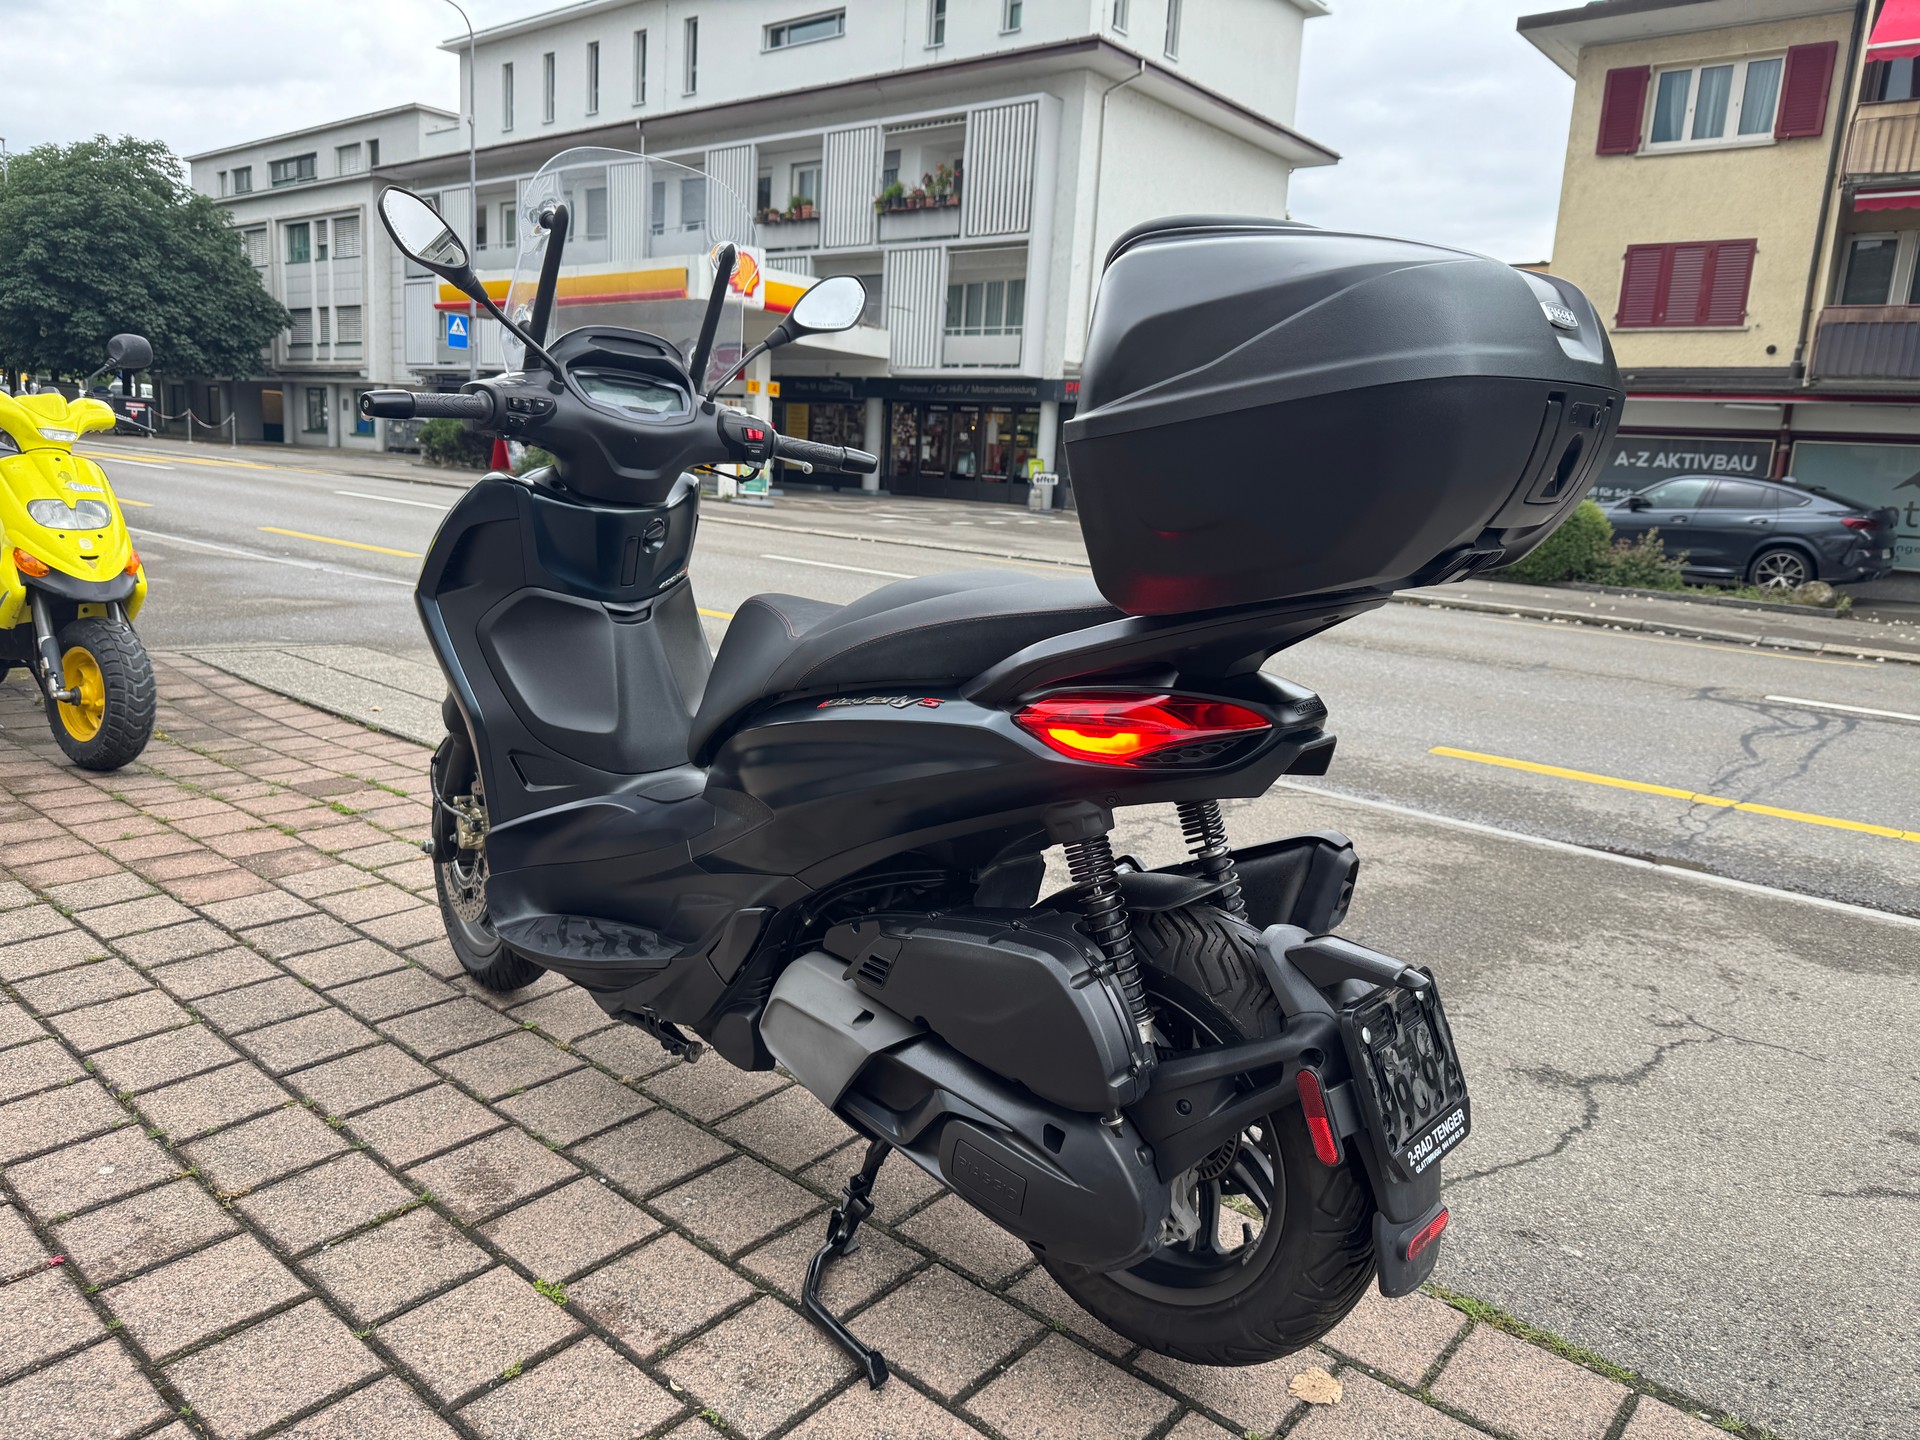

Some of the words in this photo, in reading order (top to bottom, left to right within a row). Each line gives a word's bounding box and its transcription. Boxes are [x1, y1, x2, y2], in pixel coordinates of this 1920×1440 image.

[1614, 450, 1650, 467] A-Z
[1652, 452, 1757, 471] AKTIVBAU
[1408, 1135, 1433, 1167] 2-RAD
[1431, 1108, 1465, 1144] TENGER
